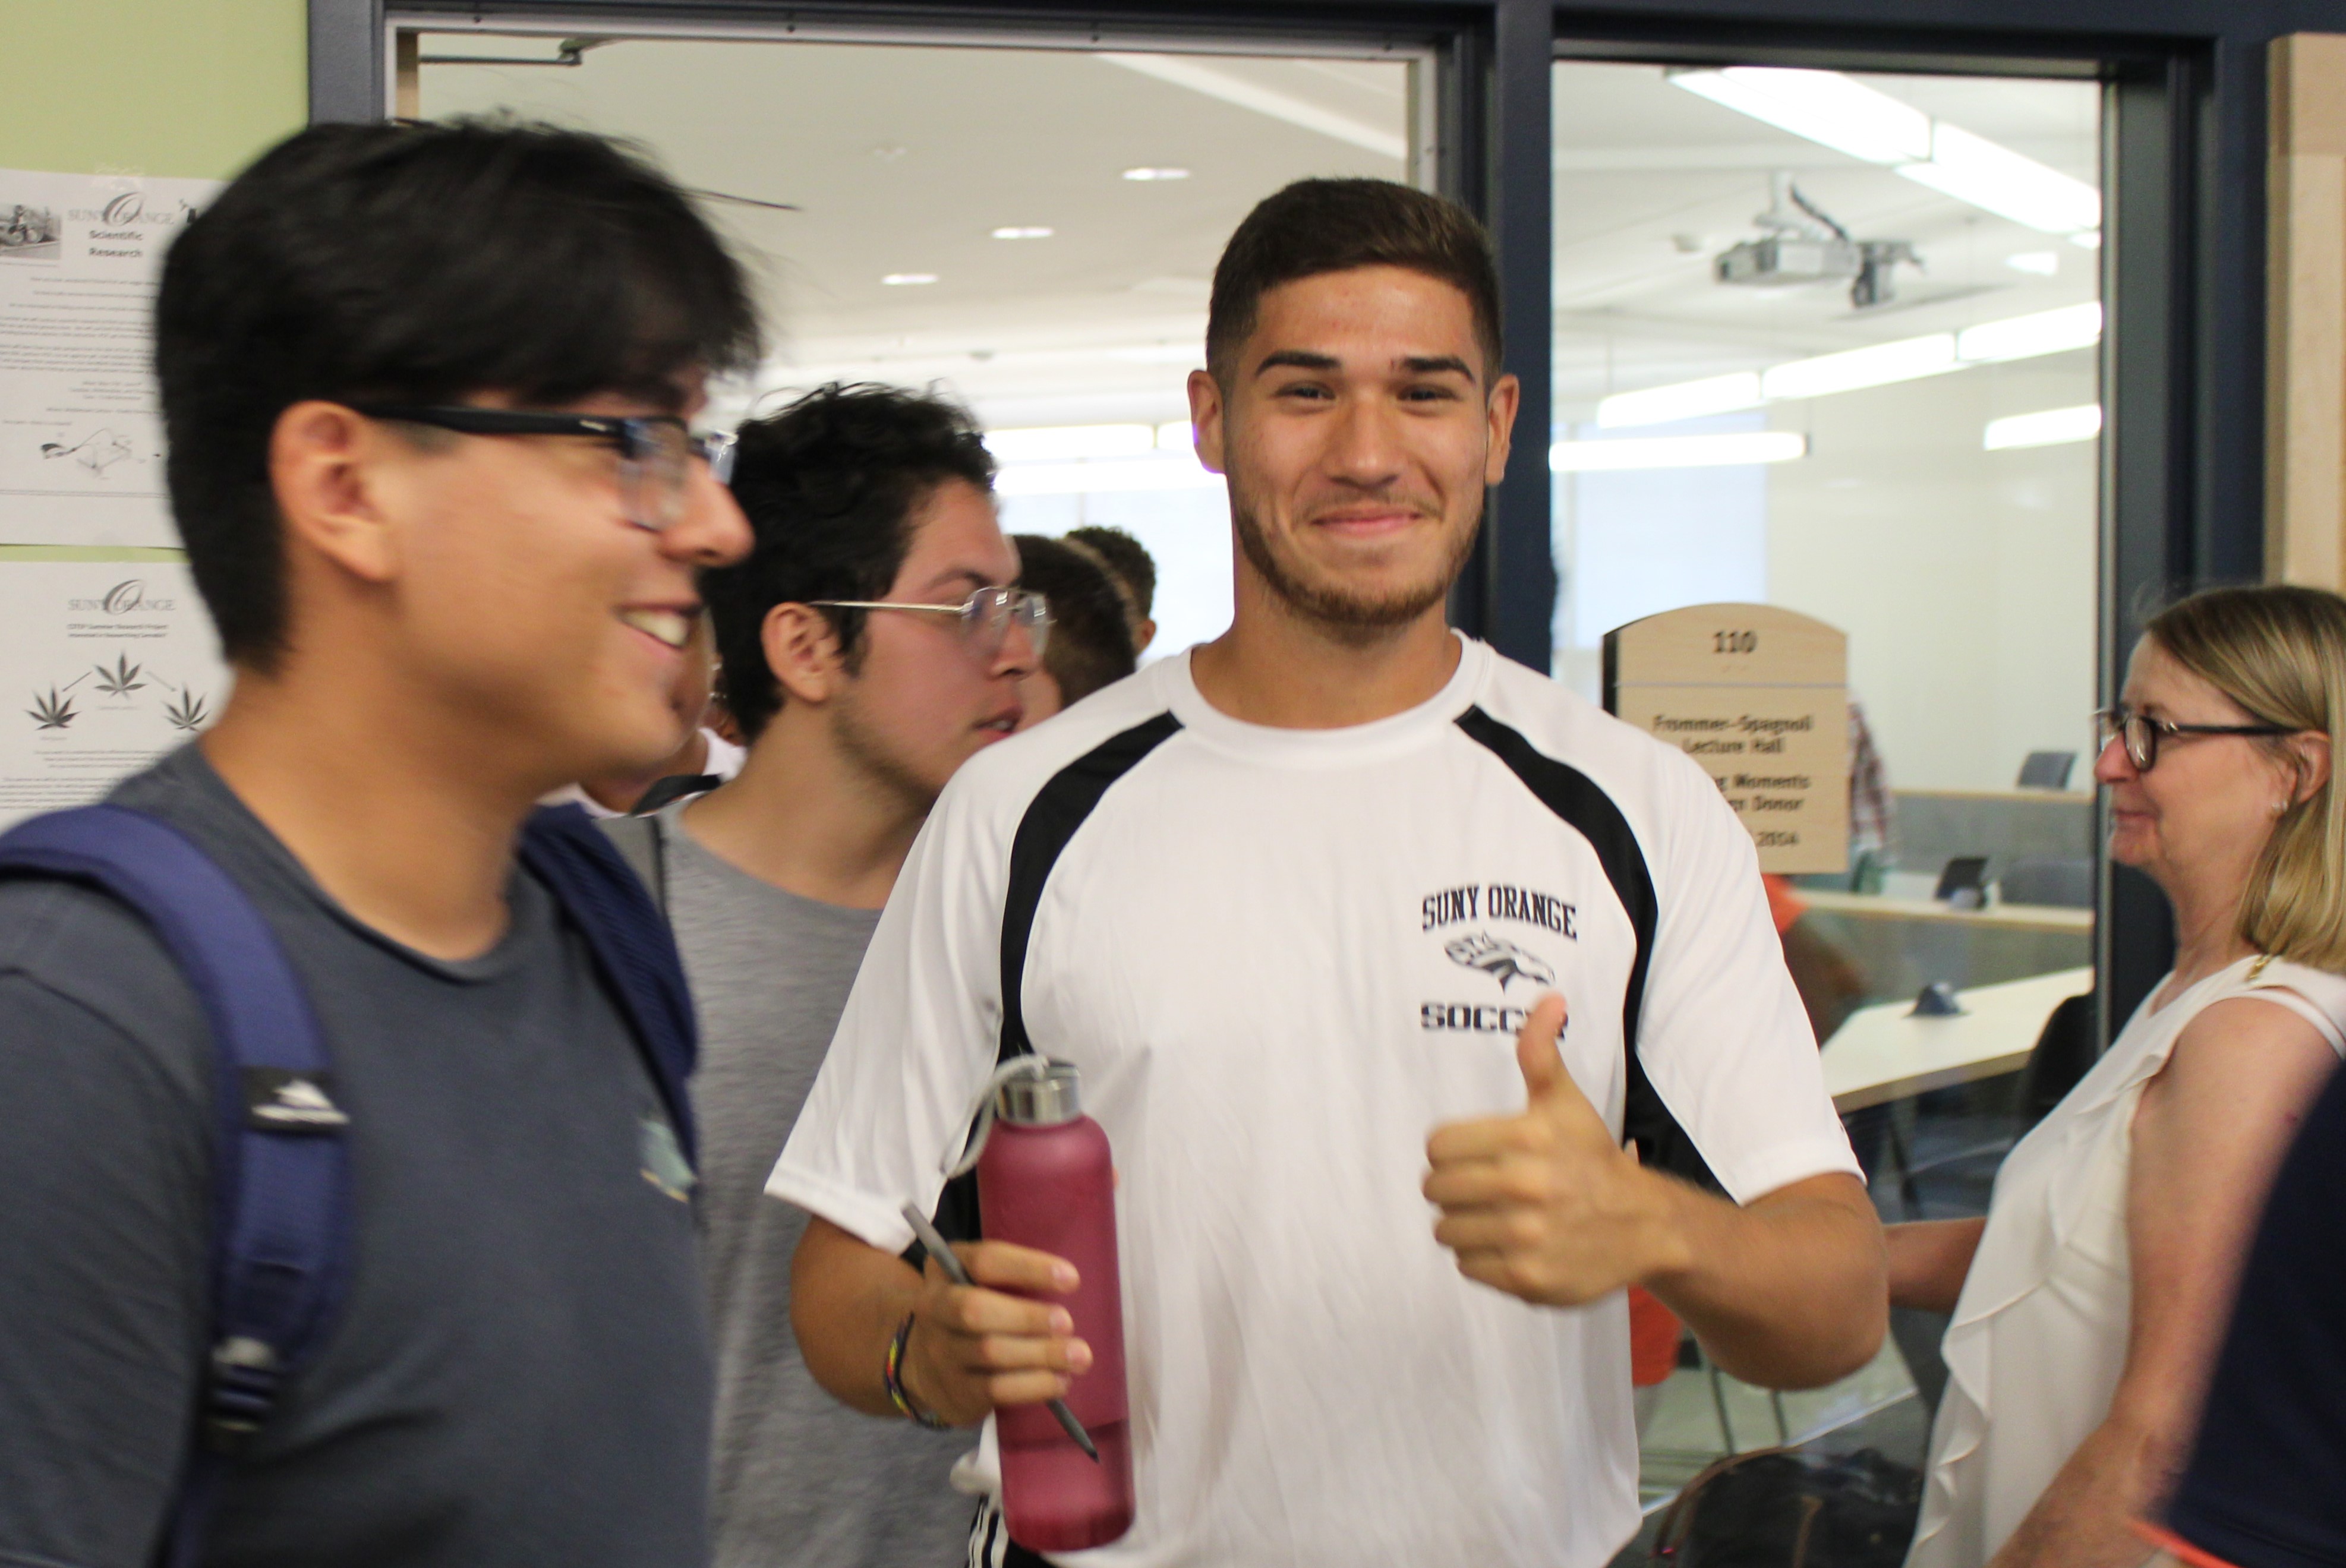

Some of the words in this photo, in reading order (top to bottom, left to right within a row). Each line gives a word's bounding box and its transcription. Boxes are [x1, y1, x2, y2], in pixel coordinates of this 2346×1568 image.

[89, 230, 143, 241] Scientific
[89, 247, 143, 257] Research
[1713, 629, 1758, 654] 110
[1682, 737, 1746, 754] Lecture
[1750, 737, 1785, 754] Hall
[1733, 773, 1811, 789] Moments
[1752, 795, 1803, 811] Donor
[1422, 884, 1480, 933] SUNY
[1487, 884, 1578, 942] ORANGE
[1420, 1001, 1569, 1040] SOCC
